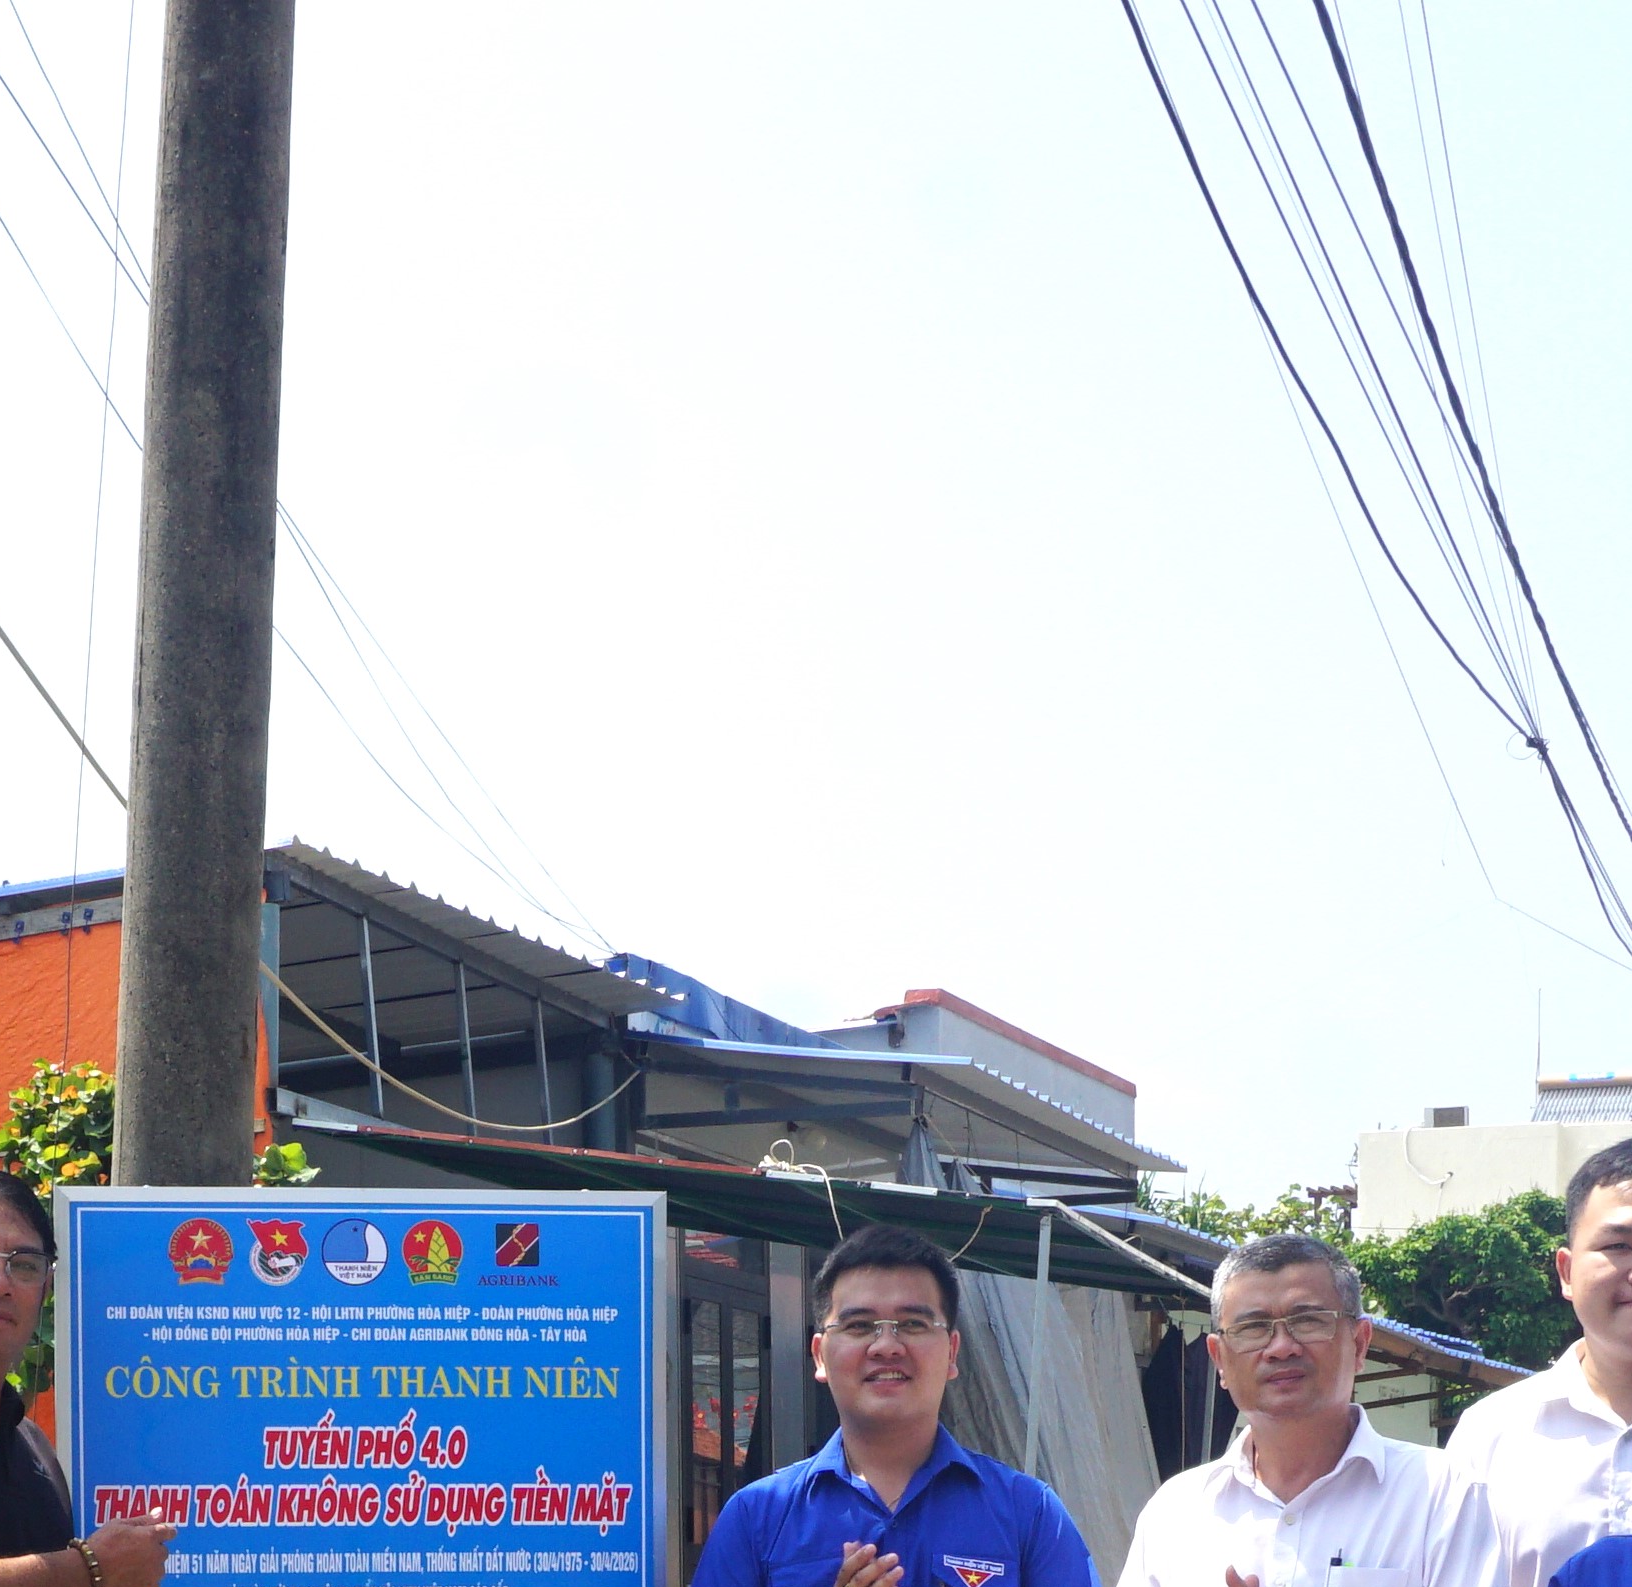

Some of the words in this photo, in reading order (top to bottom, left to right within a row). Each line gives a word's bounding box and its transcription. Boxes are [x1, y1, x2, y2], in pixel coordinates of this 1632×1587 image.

[477, 1274, 559, 1287] AGRIBANK
[106, 1306, 127, 1320] CHI
[130, 1304, 163, 1320] ĐOÀN
[166, 1304, 193, 1322] VIỆN
[197, 1306, 229, 1320] KSND
[233, 1306, 256, 1320] KHU
[259, 1306, 283, 1323] VỰC
[286, 1306, 301, 1320] 12
[311, 1304, 331, 1322] HỘI
[335, 1306, 364, 1320] LHTN
[367, 1304, 415, 1320] PHƯỜNG
[444, 1304, 471, 1323] HIỆP
[482, 1304, 514, 1321] ĐOÀN
[516, 1304, 564, 1321] PHƯỜNG
[592, 1306, 618, 1324] HIỆP
[152, 1325, 172, 1343] HỘI
[211, 1325, 232, 1343] ĐỘI
[235, 1325, 283, 1341] PHƯỜNG
[313, 1325, 340, 1343] HIỆP
[351, 1327, 371, 1341] CHI
[374, 1325, 407, 1341] ĐOÀN
[409, 1327, 469, 1342] AGRIBANK
[471, 1325, 503, 1342] ĐÔNG
[540, 1325, 560, 1342] TÂY
[105, 1355, 221, 1399] CÔNG
[231, 1356, 361, 1399] TRÌNH
[372, 1365, 512, 1399] THANH
[523, 1356, 620, 1399] NIÊN
[264, 1408, 353, 1469] TUYẾN
[354, 1408, 417, 1469] PHỐ
[420, 1426, 468, 1469] 4.0
[94, 1485, 191, 1527] THANH
[195, 1473, 275, 1527] TOÁN
[276, 1473, 382, 1527] KHÔNG
[383, 1470, 426, 1526] SỬ
[424, 1482, 507, 1538] DỤNG
[511, 1465, 572, 1526] TIỀN
[572, 1471, 633, 1538] MẶT
[192, 1554, 203, 1574] 51
[206, 1549, 229, 1574] NĂM
[231, 1549, 256, 1574] NGÀY
[259, 1546, 279, 1574] GIẢI
[317, 1548, 342, 1573] HOÀN
[344, 1548, 370, 1573] TOÀN
[398, 1552, 424, 1575] NAM,
[426, 1545, 457, 1573] THỐNG
[459, 1545, 484, 1573] NHẤT
[485, 1545, 504, 1573] ĐẤT
[506, 1548, 531, 1573] NƯỚC
[533, 1552, 582, 1574] (30/4/1975
[590, 1552, 638, 1574] 30/4/2026)
